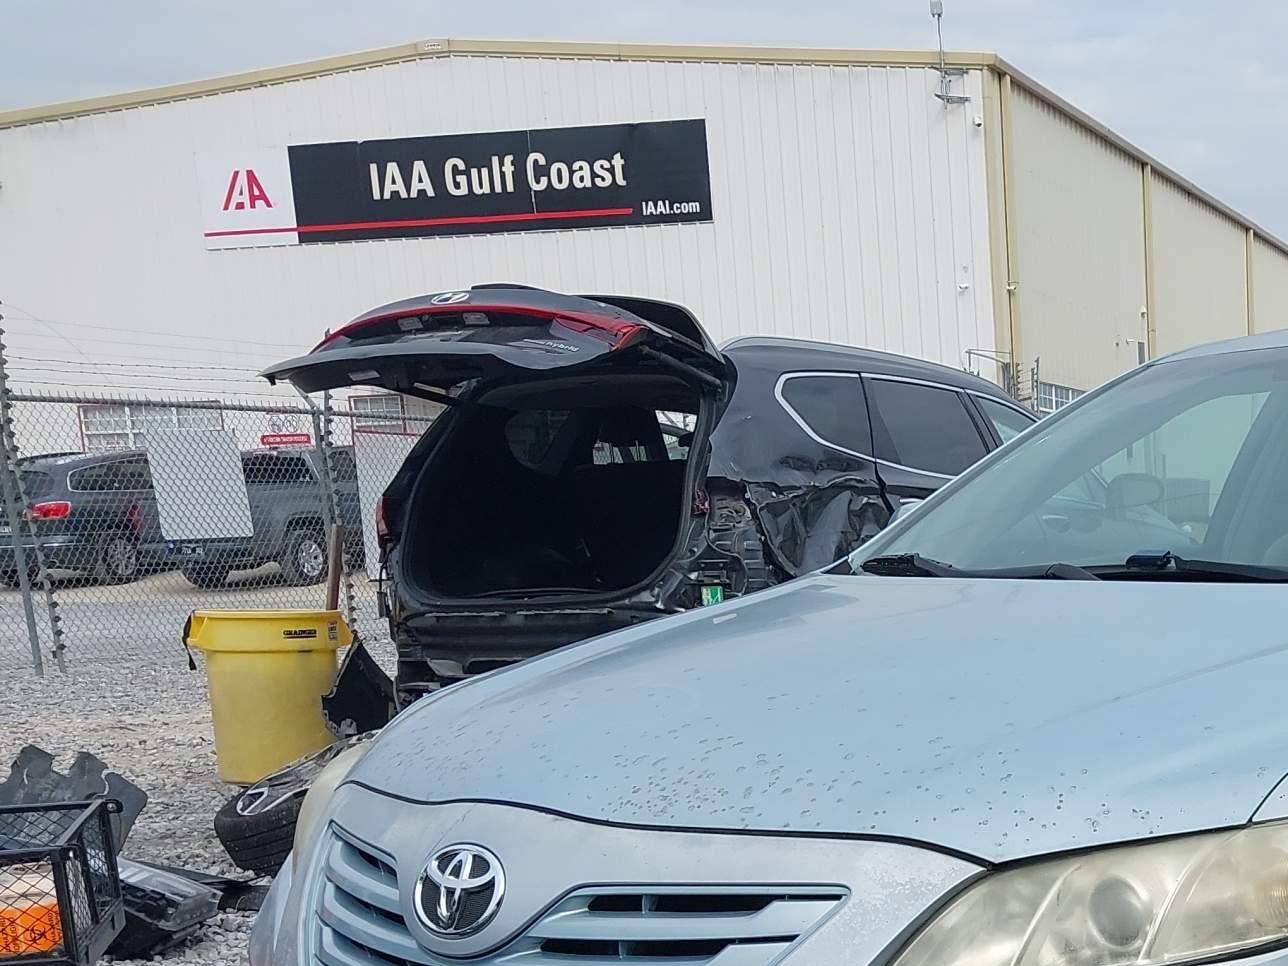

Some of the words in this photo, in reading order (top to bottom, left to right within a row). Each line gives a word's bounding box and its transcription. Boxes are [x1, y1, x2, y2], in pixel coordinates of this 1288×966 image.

[369, 160, 436, 200] IAA
[444, 154, 515, 196] Gulf
[526, 151, 627, 191] Coast
